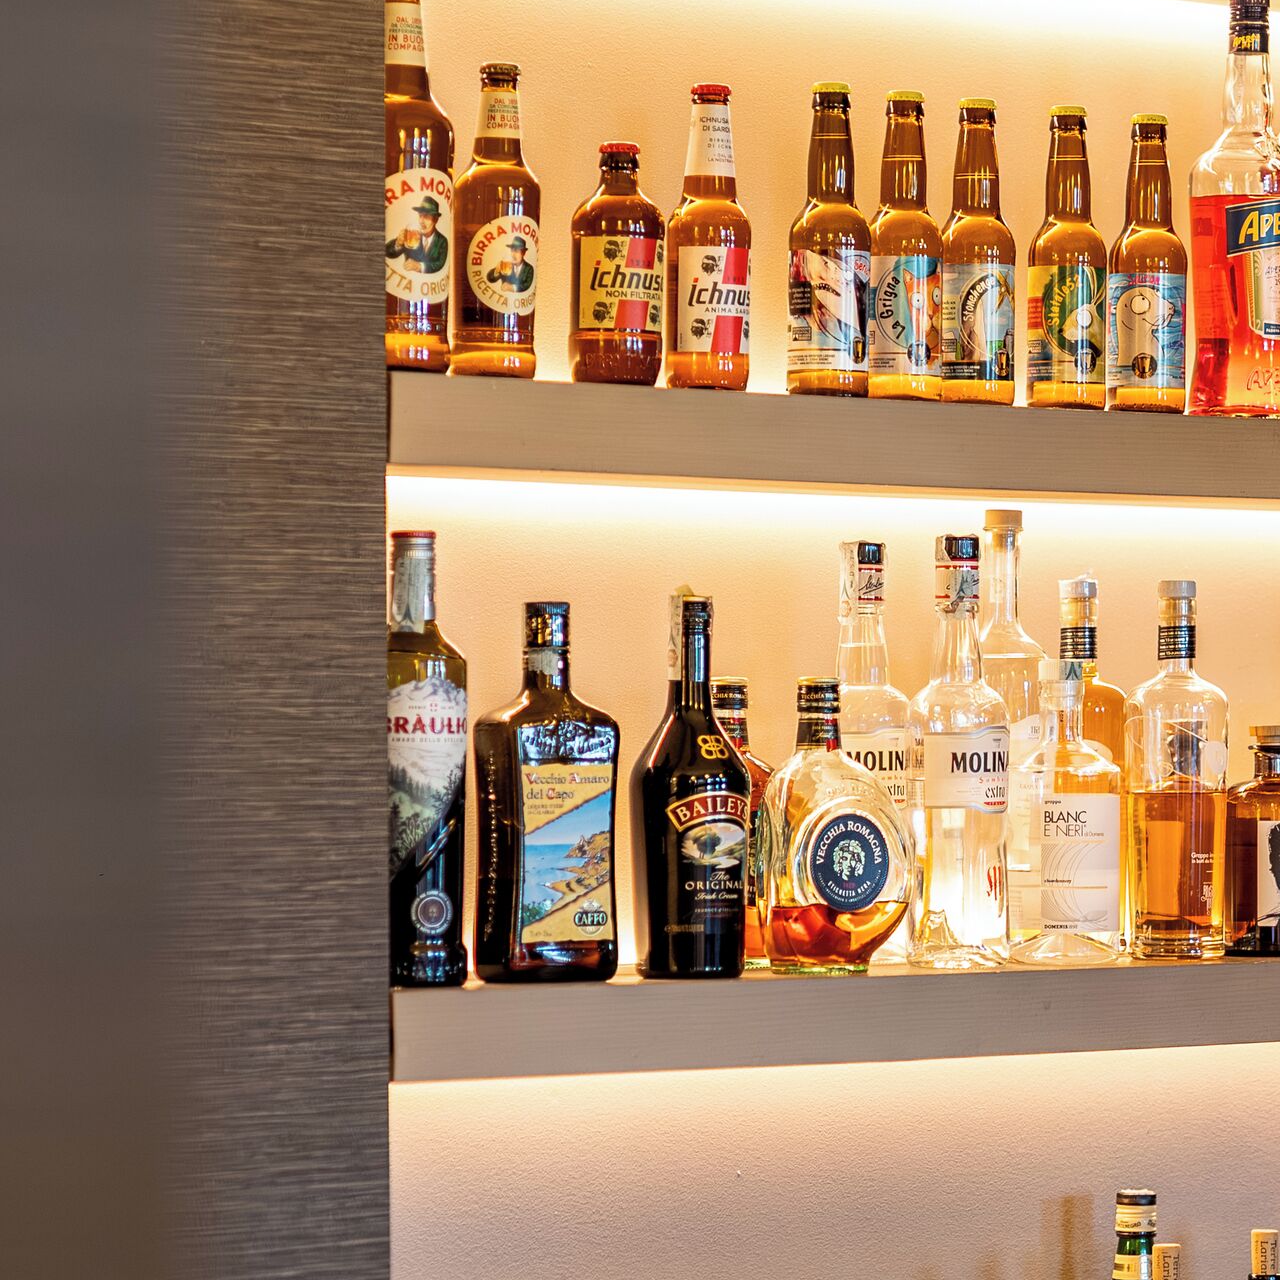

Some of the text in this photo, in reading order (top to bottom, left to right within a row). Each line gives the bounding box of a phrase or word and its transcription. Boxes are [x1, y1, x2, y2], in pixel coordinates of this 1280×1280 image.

[388, 34, 398, 42] IN
[471, 224, 507, 266] BIRRA
[472, 270, 508, 309] RICETTA
[605, 289, 628, 298] NON
[963, 275, 997, 322] Stonehenge
[879, 276, 906, 340] La Grigna
[525, 773, 610, 785] Vecchio Amaro
[526, 787, 574, 803] del Capo
[675, 797, 748, 823] BAILEYS
[1044, 810, 1088, 824] BLANC
[1043, 824, 1051, 837] E
[815, 820, 883, 865] VECCHIA ROMAGNA
[709, 871, 731, 881] The
[684, 880, 744, 891] ORIGINAL
[574, 912, 607, 926] CAFFO
[1270, 1240, 1278, 1271] Terre
